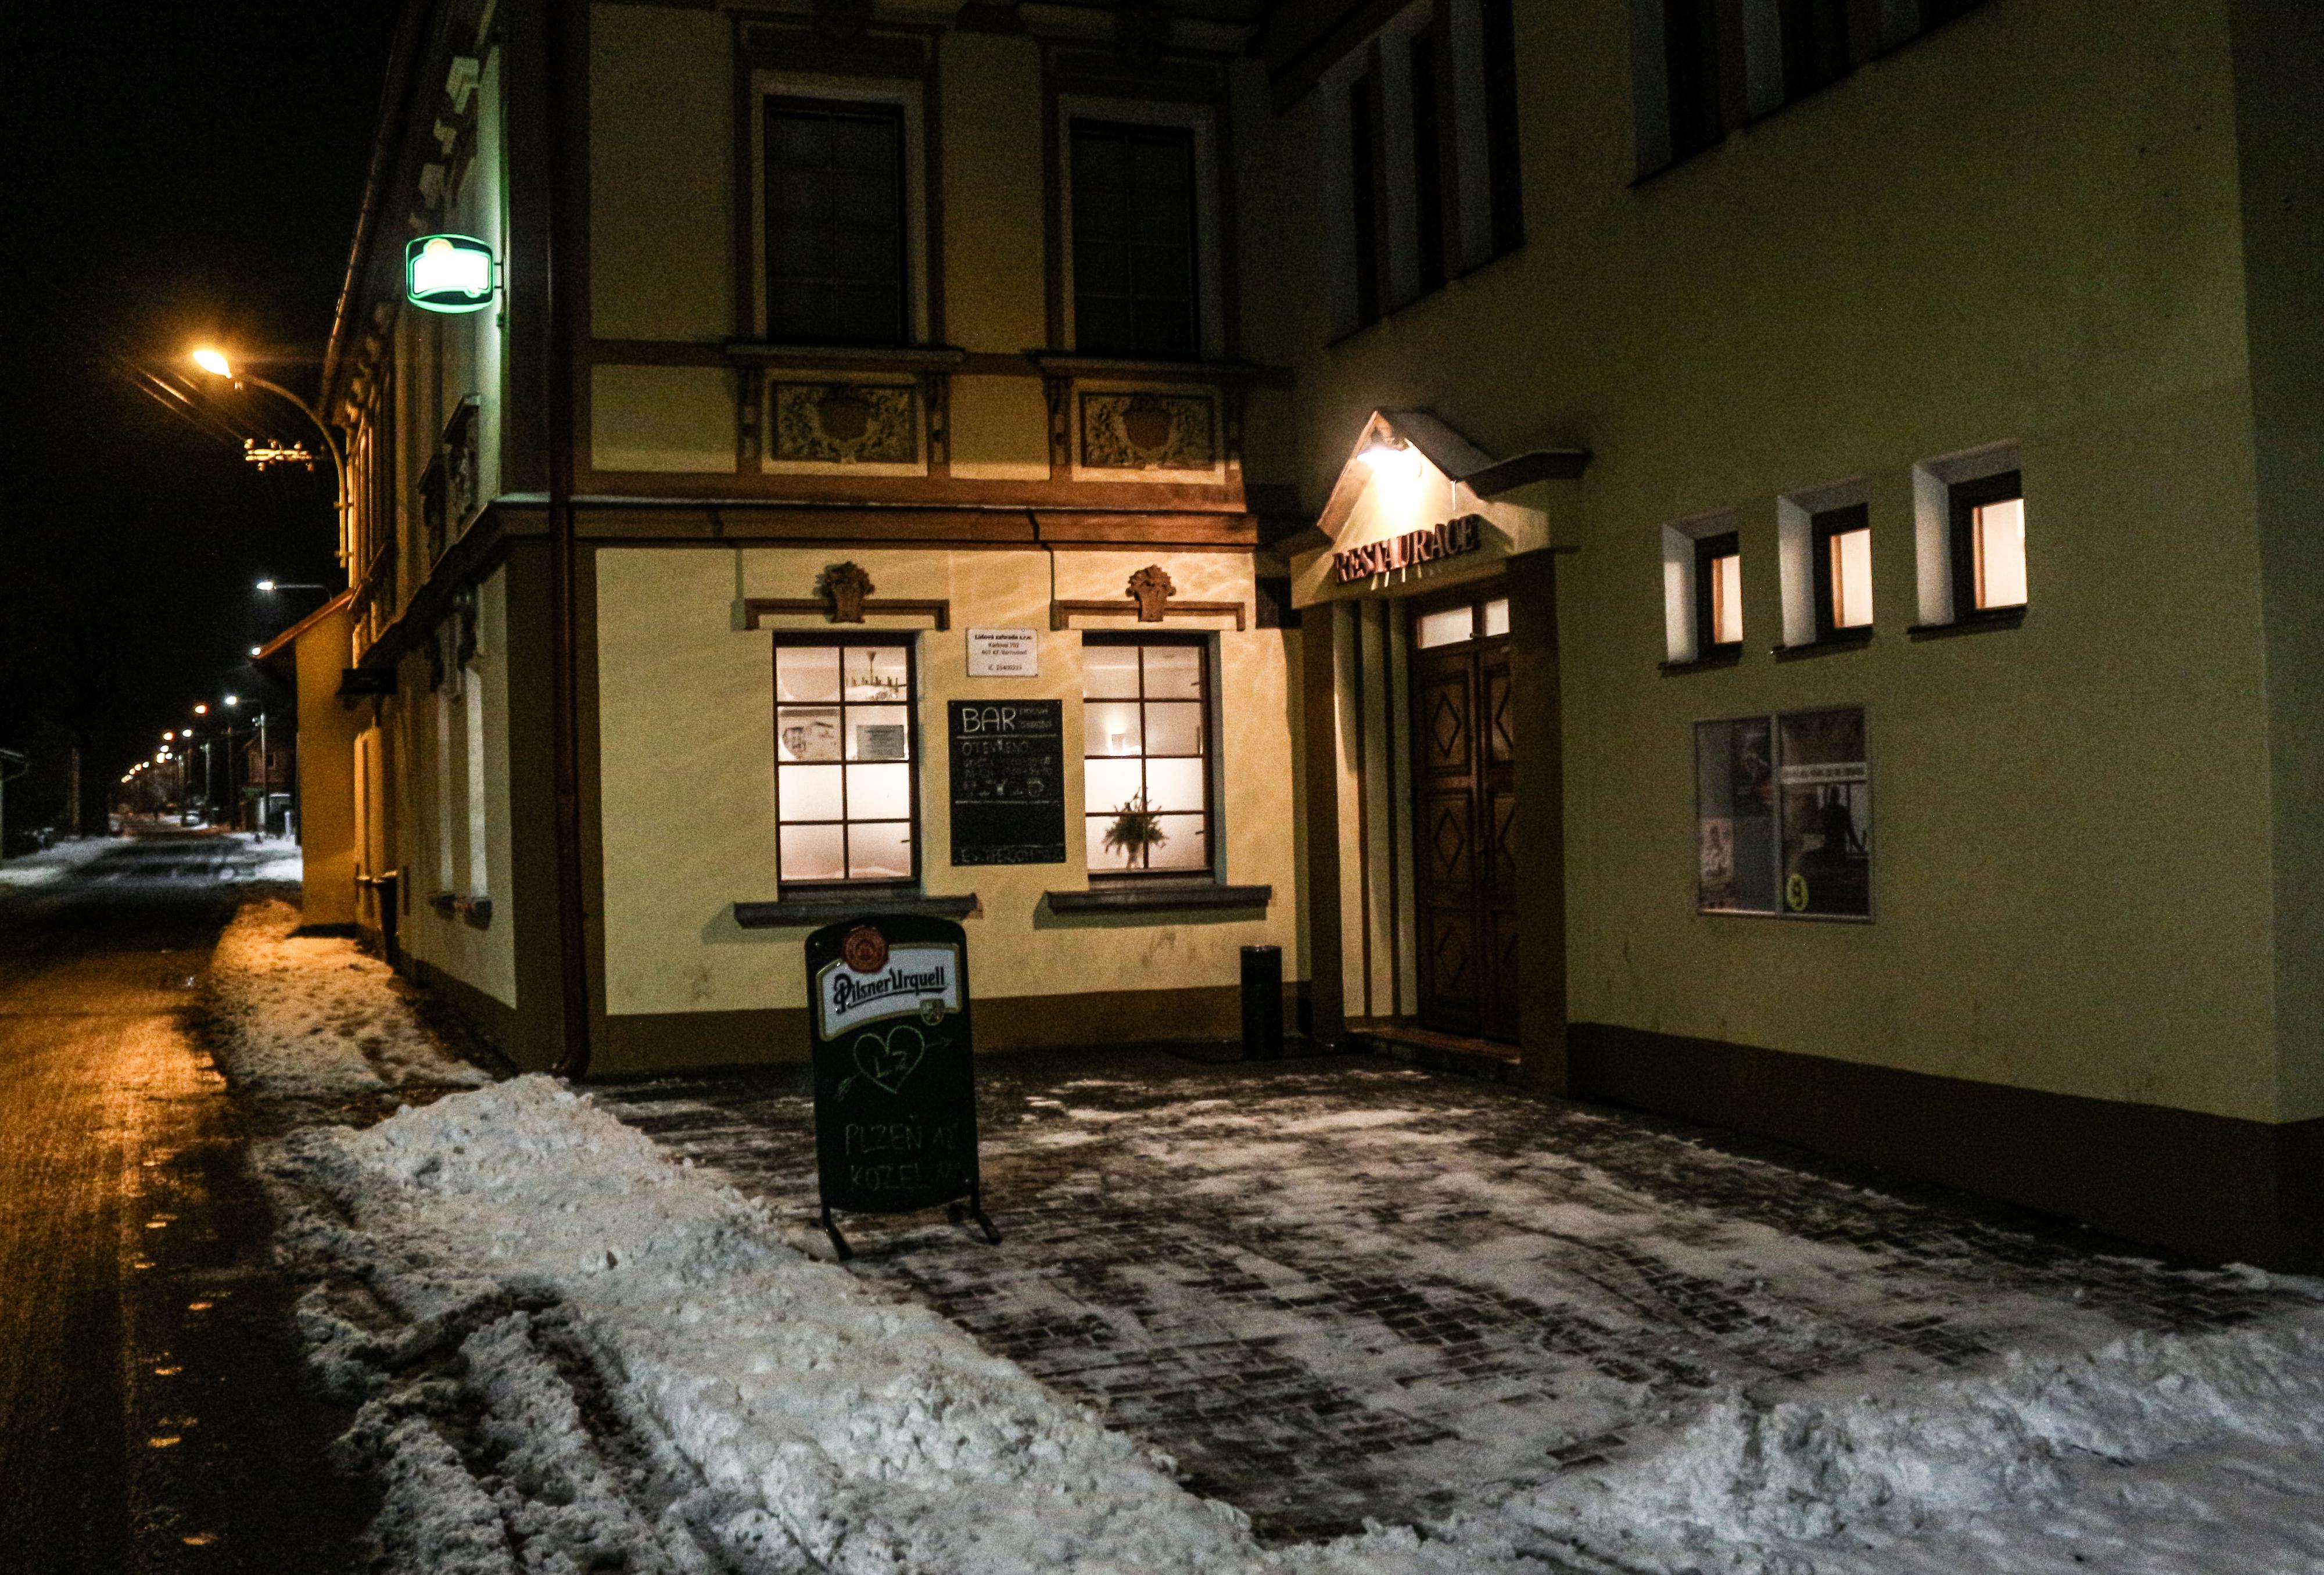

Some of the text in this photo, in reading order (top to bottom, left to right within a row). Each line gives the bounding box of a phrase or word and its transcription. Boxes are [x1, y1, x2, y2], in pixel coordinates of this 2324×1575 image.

[1335, 514, 1482, 582] RESTAURACE
[962, 706, 1016, 733] BAR
[833, 973, 891, 1014] Pilsner
[889, 966, 945, 996] Urquell
